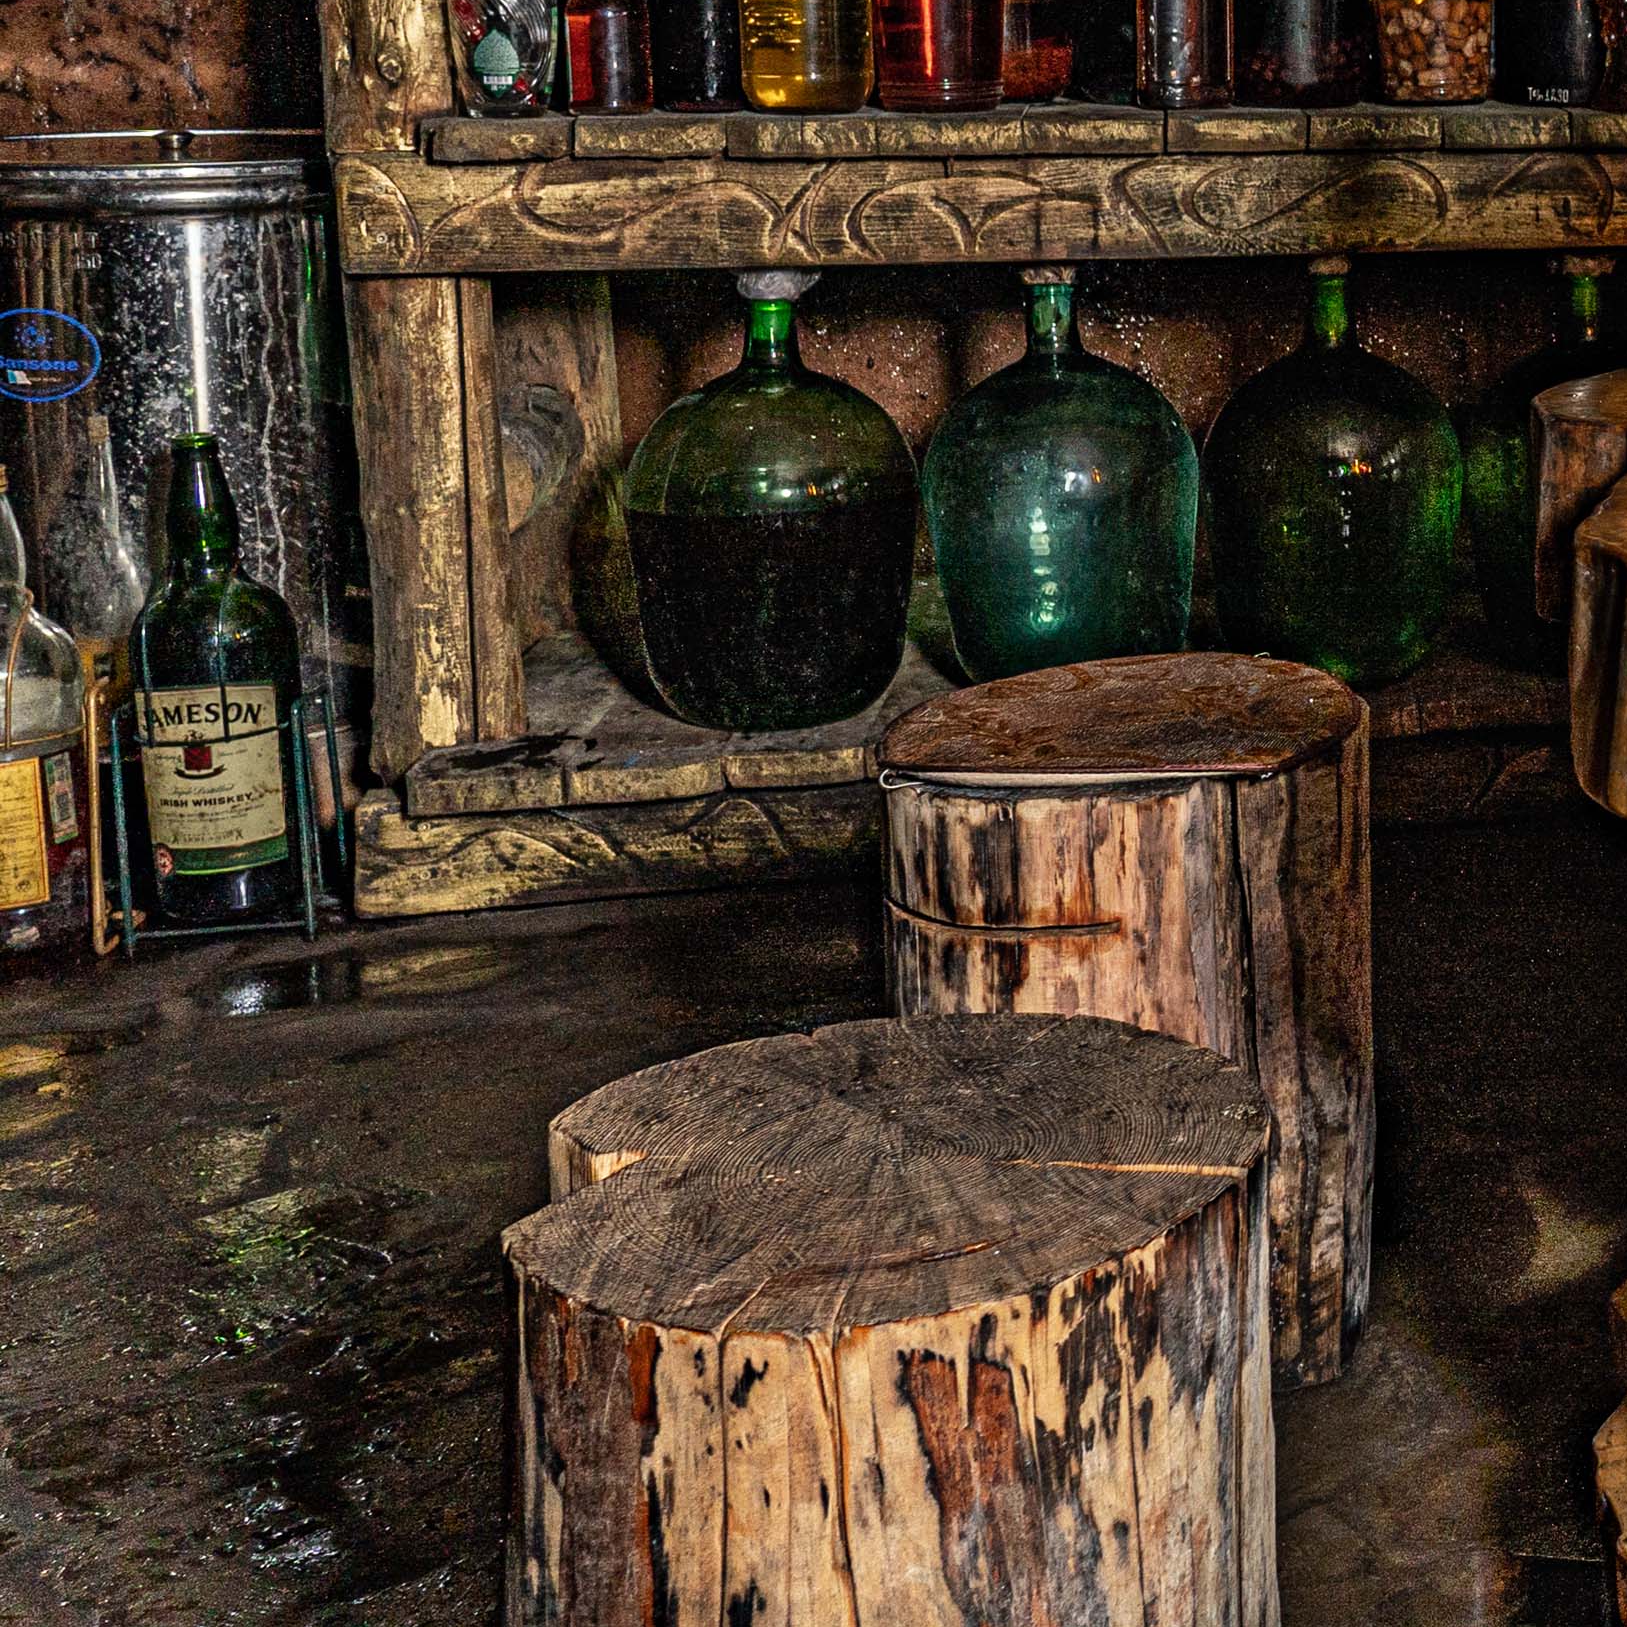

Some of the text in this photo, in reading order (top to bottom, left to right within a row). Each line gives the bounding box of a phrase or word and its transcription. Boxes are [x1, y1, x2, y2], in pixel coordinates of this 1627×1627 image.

[142, 701, 262, 731] AMESON
[160, 791, 254, 808] IRISH WHISKEY
